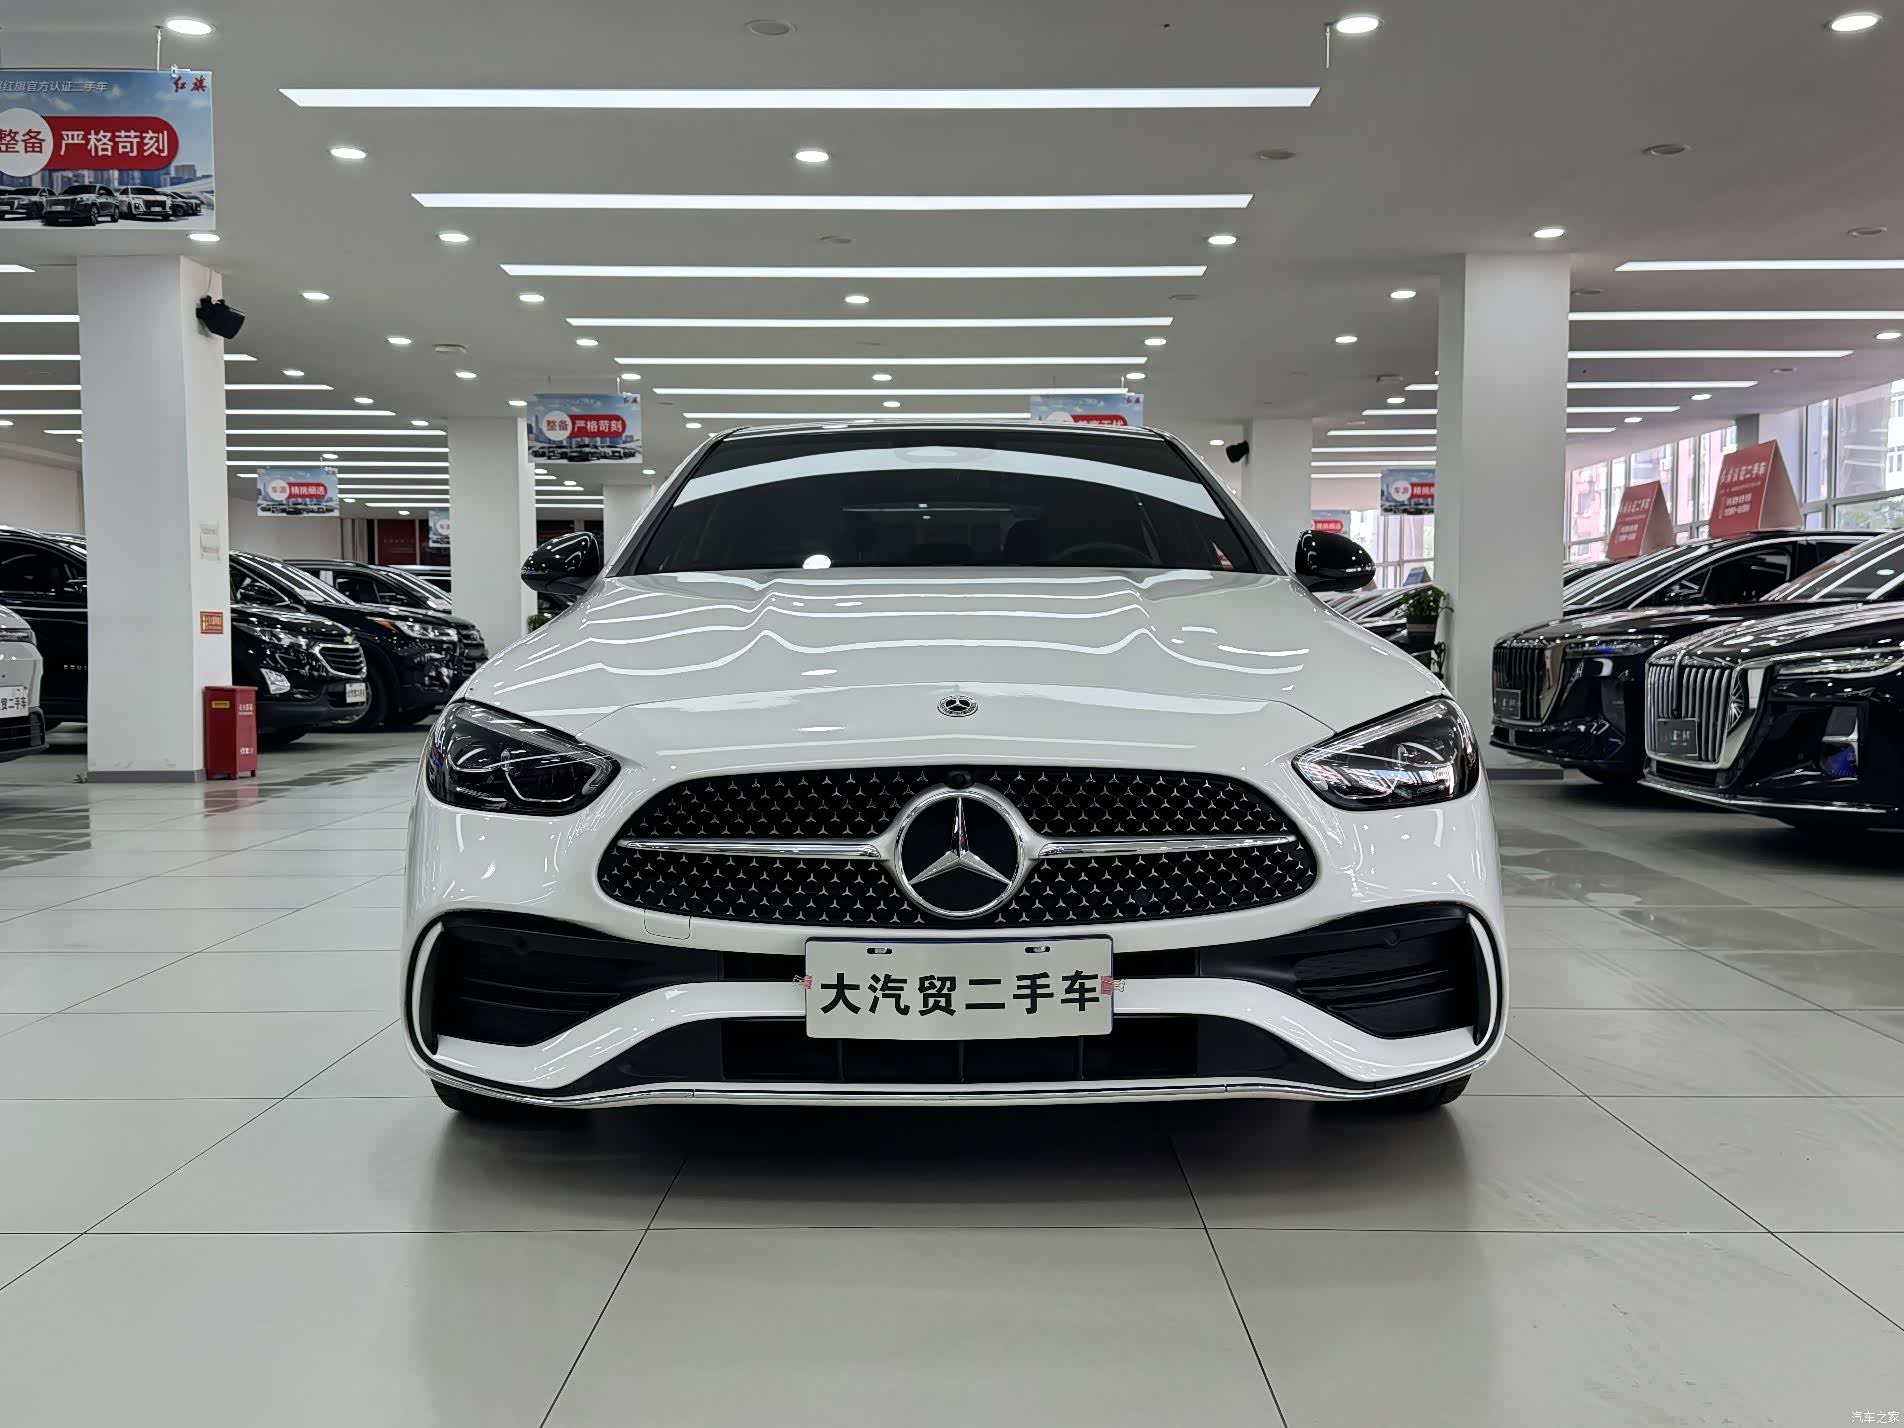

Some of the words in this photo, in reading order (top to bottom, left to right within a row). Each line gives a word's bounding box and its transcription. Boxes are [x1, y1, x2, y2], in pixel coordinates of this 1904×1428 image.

[0, 80, 109, 93] 红旗官方认证二手车
[173, 75, 207, 92] 红旗
[0, 128, 46, 154] 整备
[60, 130, 168, 156] 严格苛刻
[574, 420, 622, 433] 严格苛刻
[0, 697, 27, 711] 贸二手车
[820, 970, 1100, 1016] 大汽贸二手车
